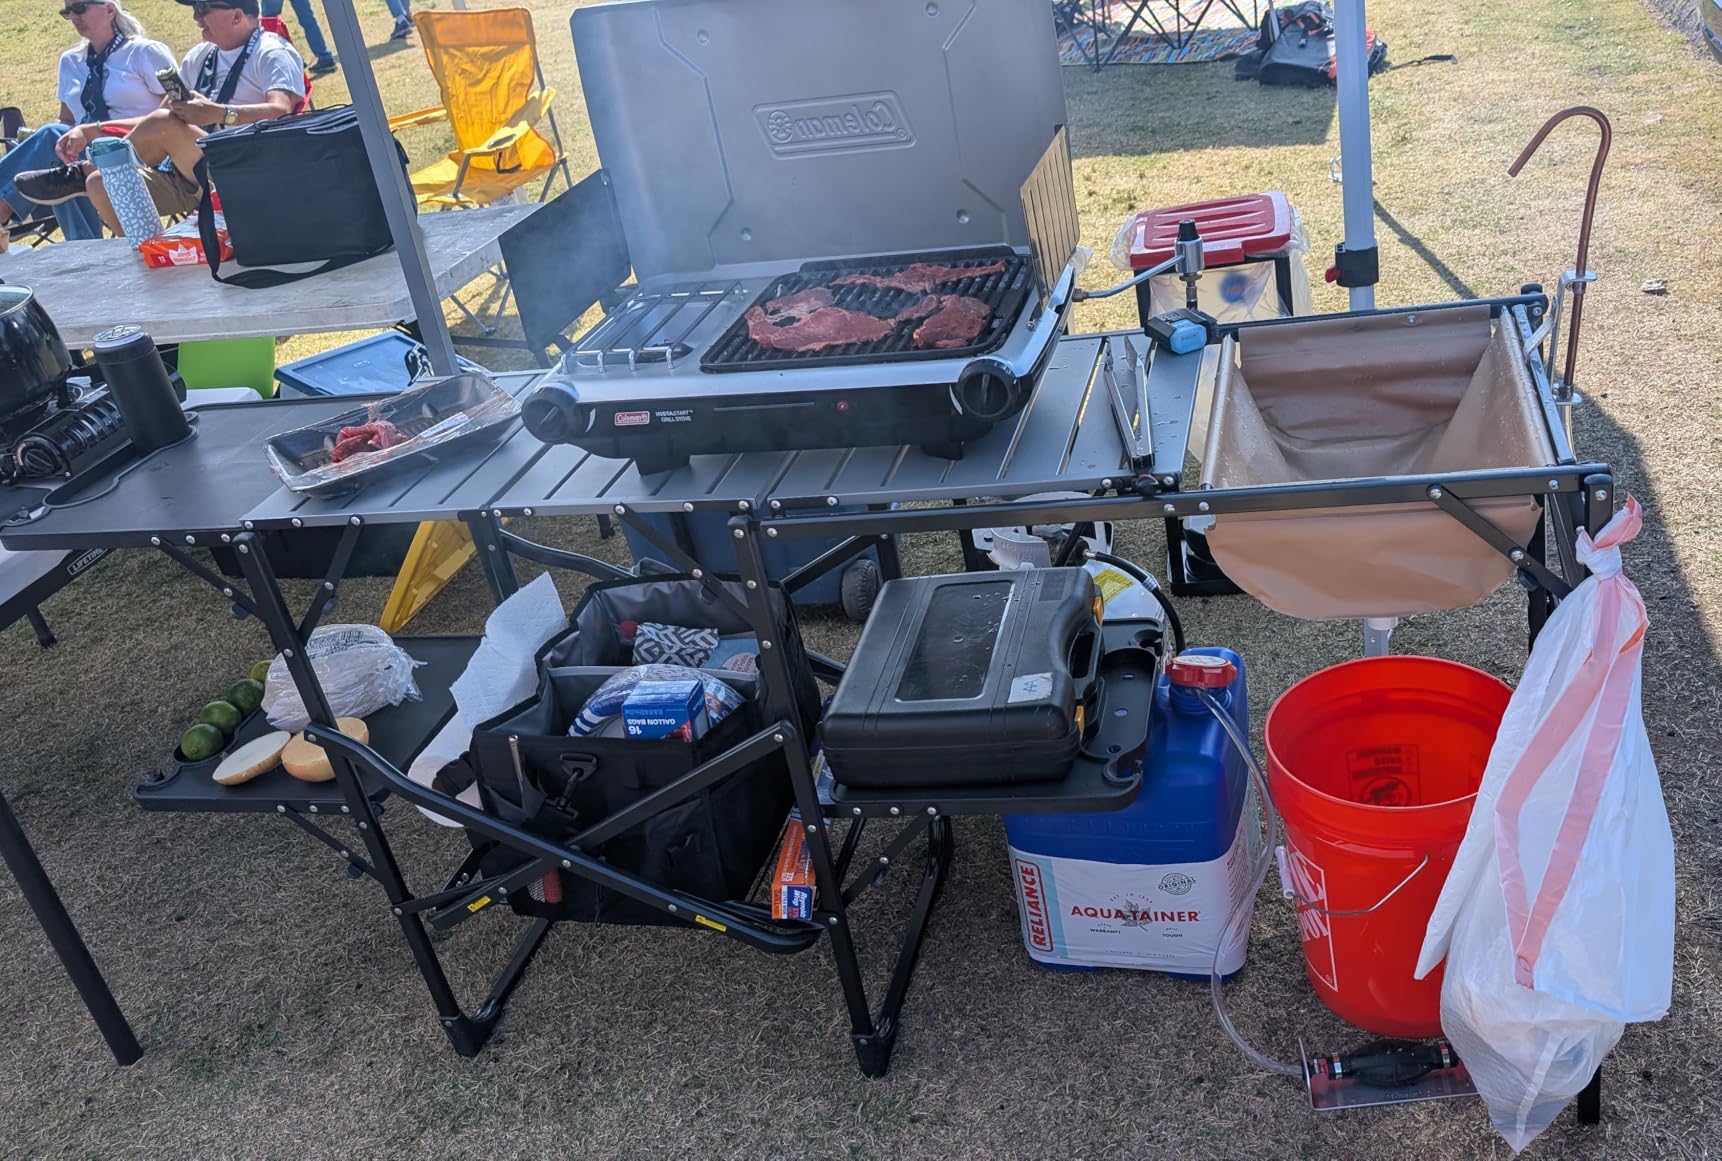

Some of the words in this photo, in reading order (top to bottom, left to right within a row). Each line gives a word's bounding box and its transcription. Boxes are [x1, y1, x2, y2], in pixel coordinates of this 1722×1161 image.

[626, 717, 647, 726] BAGS
[646, 717, 677, 726] GALLON
[627, 725, 643, 736] 16
[791, 889, 801, 907] Wrap
[799, 891, 808, 919] Reynolds
[1020, 865, 1048, 947] RELIANCE
